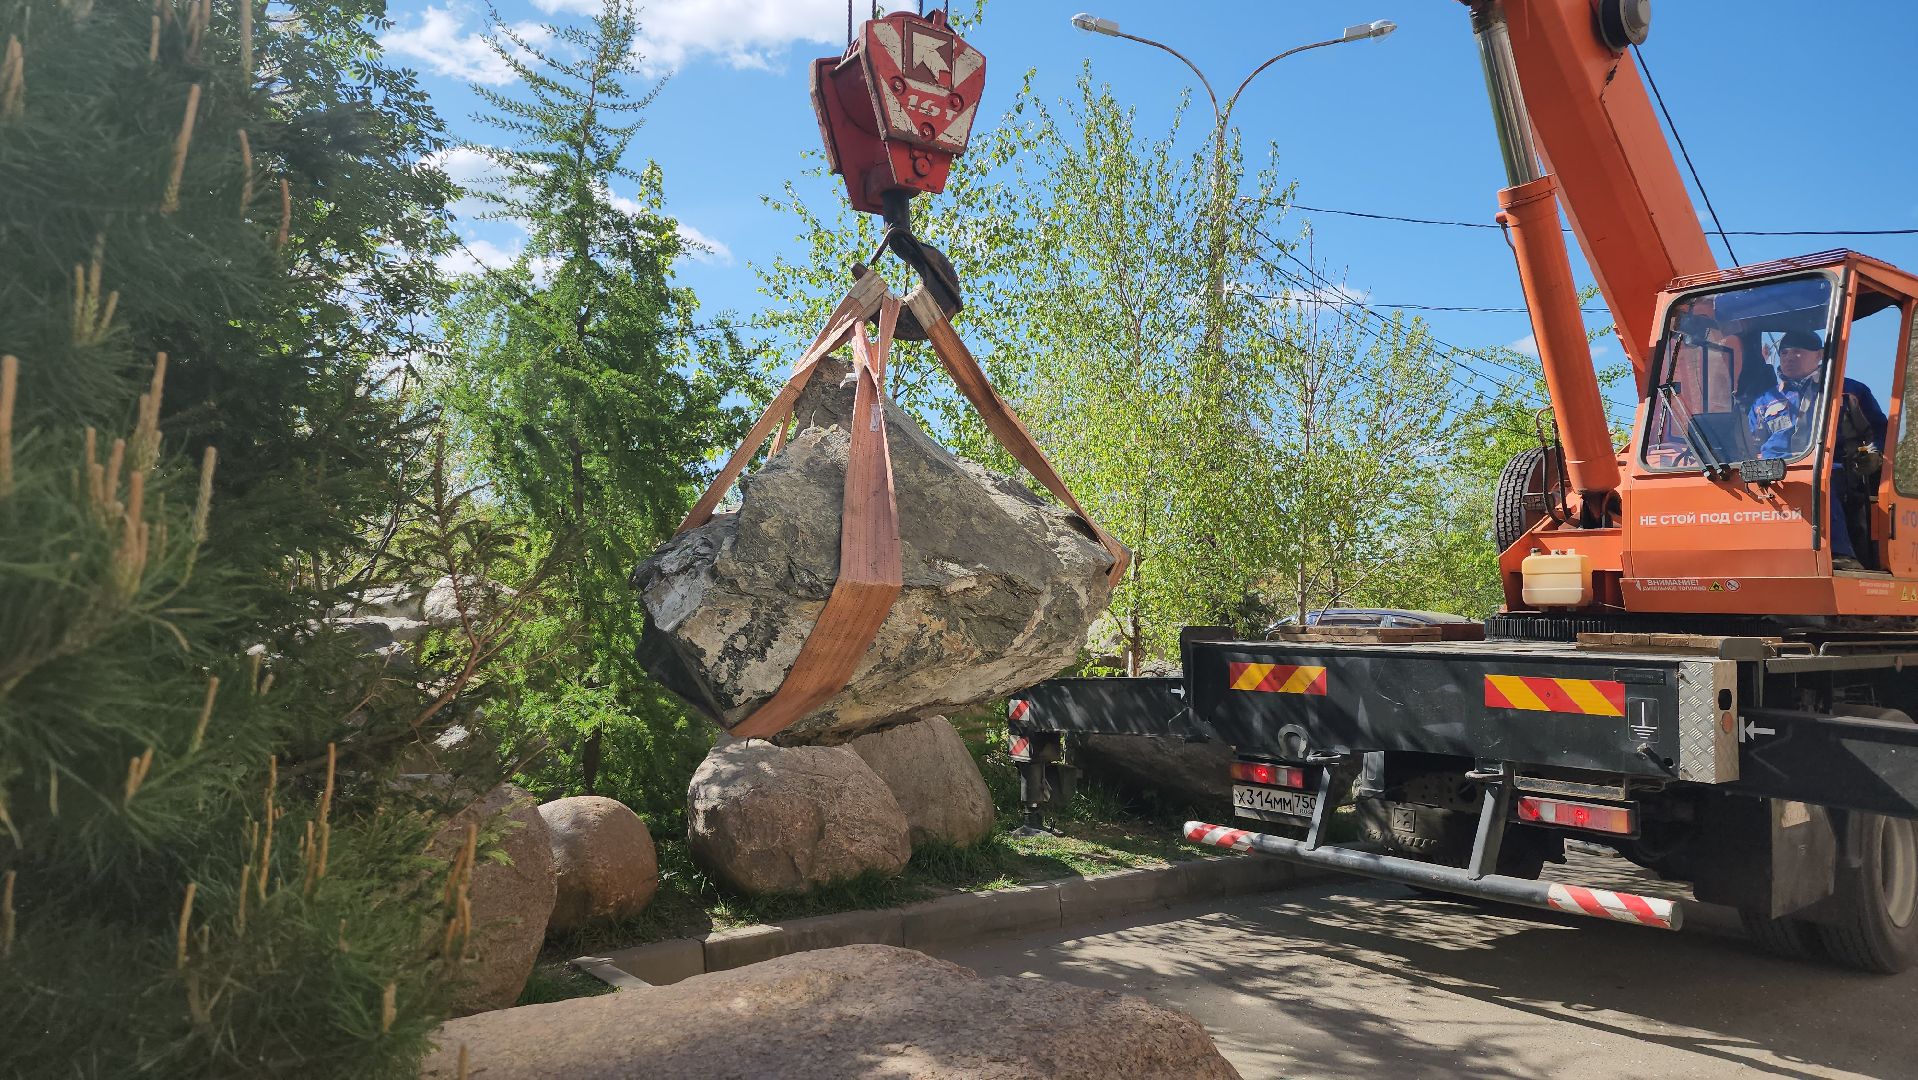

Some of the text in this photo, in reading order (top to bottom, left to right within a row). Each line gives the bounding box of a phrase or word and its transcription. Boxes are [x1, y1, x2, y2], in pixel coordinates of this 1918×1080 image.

[1639, 507, 1802, 526] НЕ СТОЙ ПОД СТРЕЛОЙ
